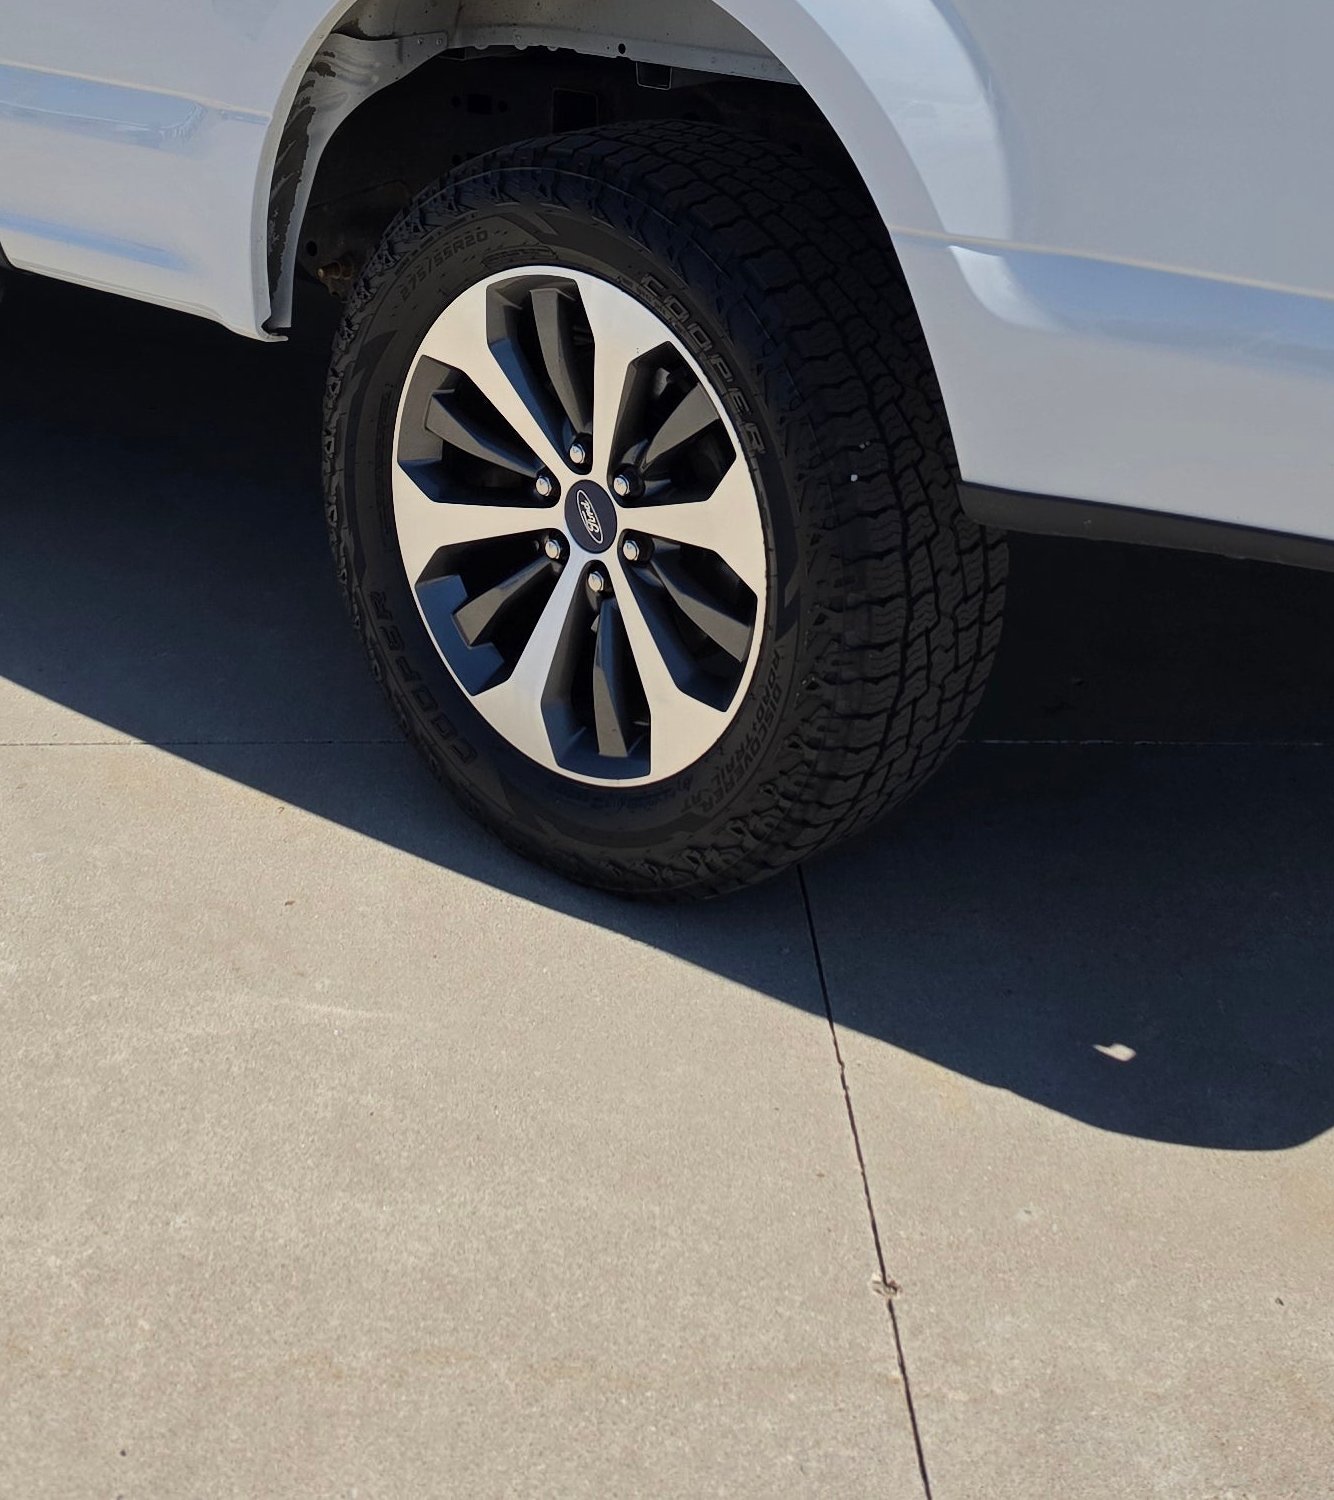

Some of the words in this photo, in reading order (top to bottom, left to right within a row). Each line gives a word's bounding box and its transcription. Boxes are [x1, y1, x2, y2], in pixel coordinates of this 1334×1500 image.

[640, 273, 766, 454] COOPER
[580, 500, 600, 533] Ford
[369, 590, 477, 764] COOPER
